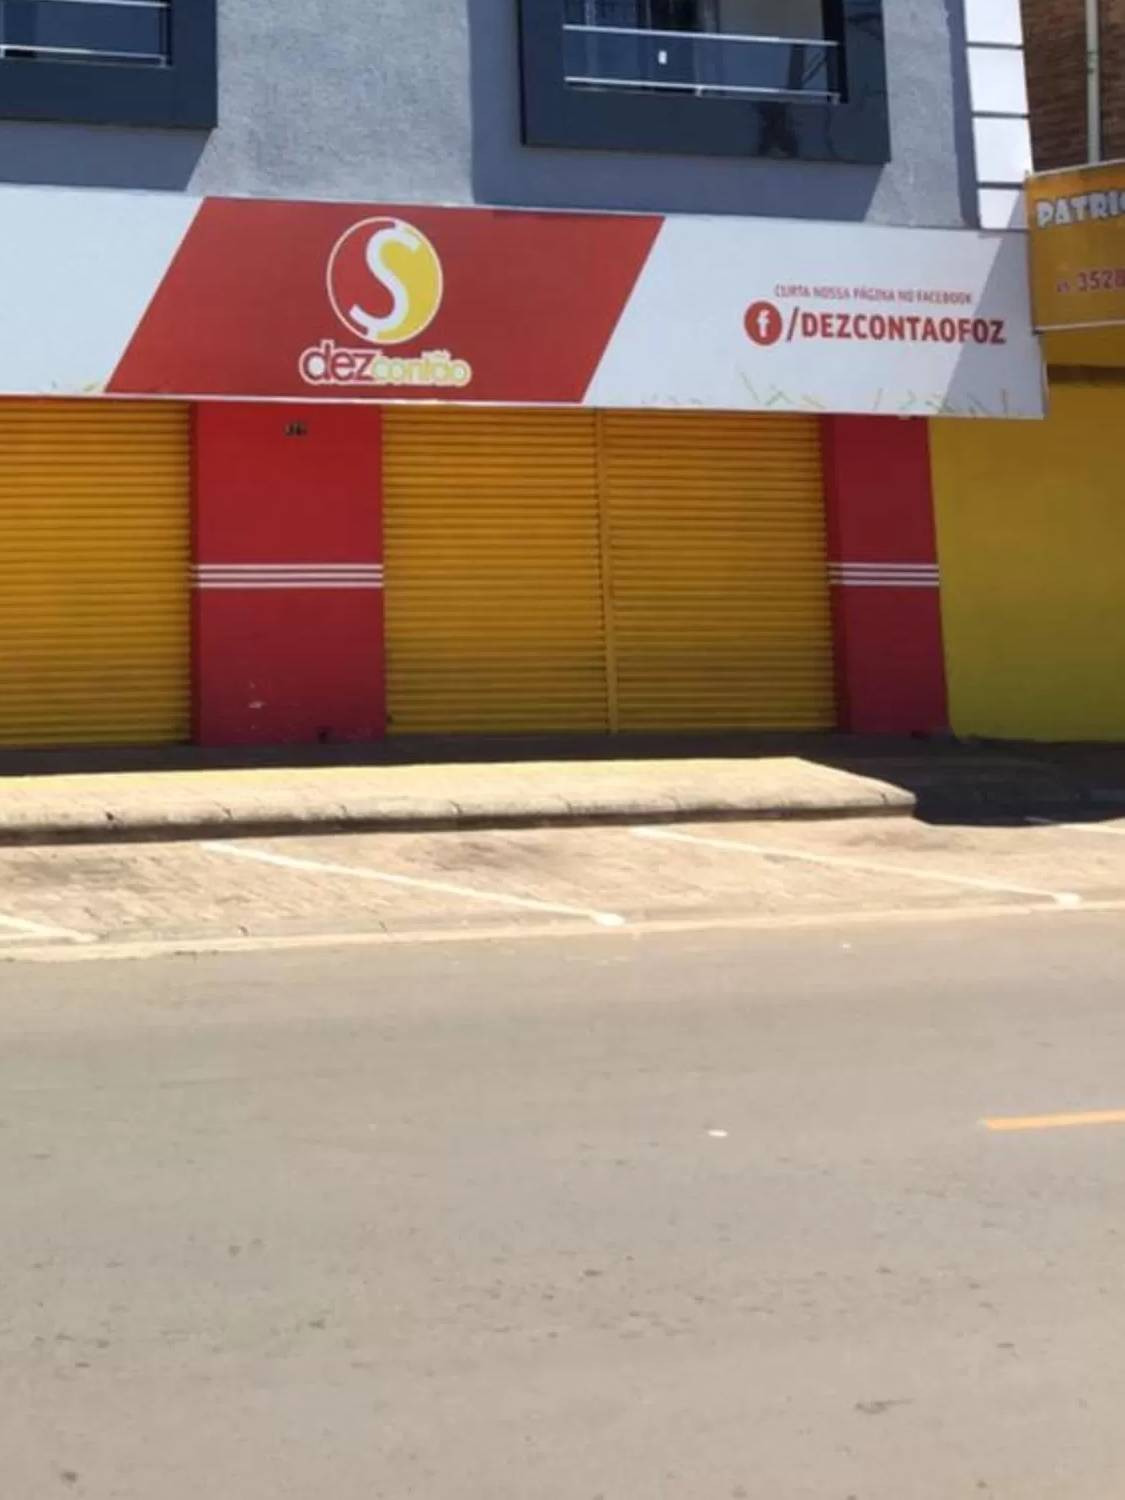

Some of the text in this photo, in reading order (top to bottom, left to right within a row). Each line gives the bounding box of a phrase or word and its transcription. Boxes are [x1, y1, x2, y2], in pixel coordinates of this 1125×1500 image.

[1036, 189, 1125, 229] PATRI
[774, 283, 811, 299] CURTA
[813, 285, 851, 300] NOSSA
[898, 290, 914, 303] NO
[917, 290, 973, 305] FACEBOOK
[785, 306, 1007, 344] /DEZCONTAOFOZ
